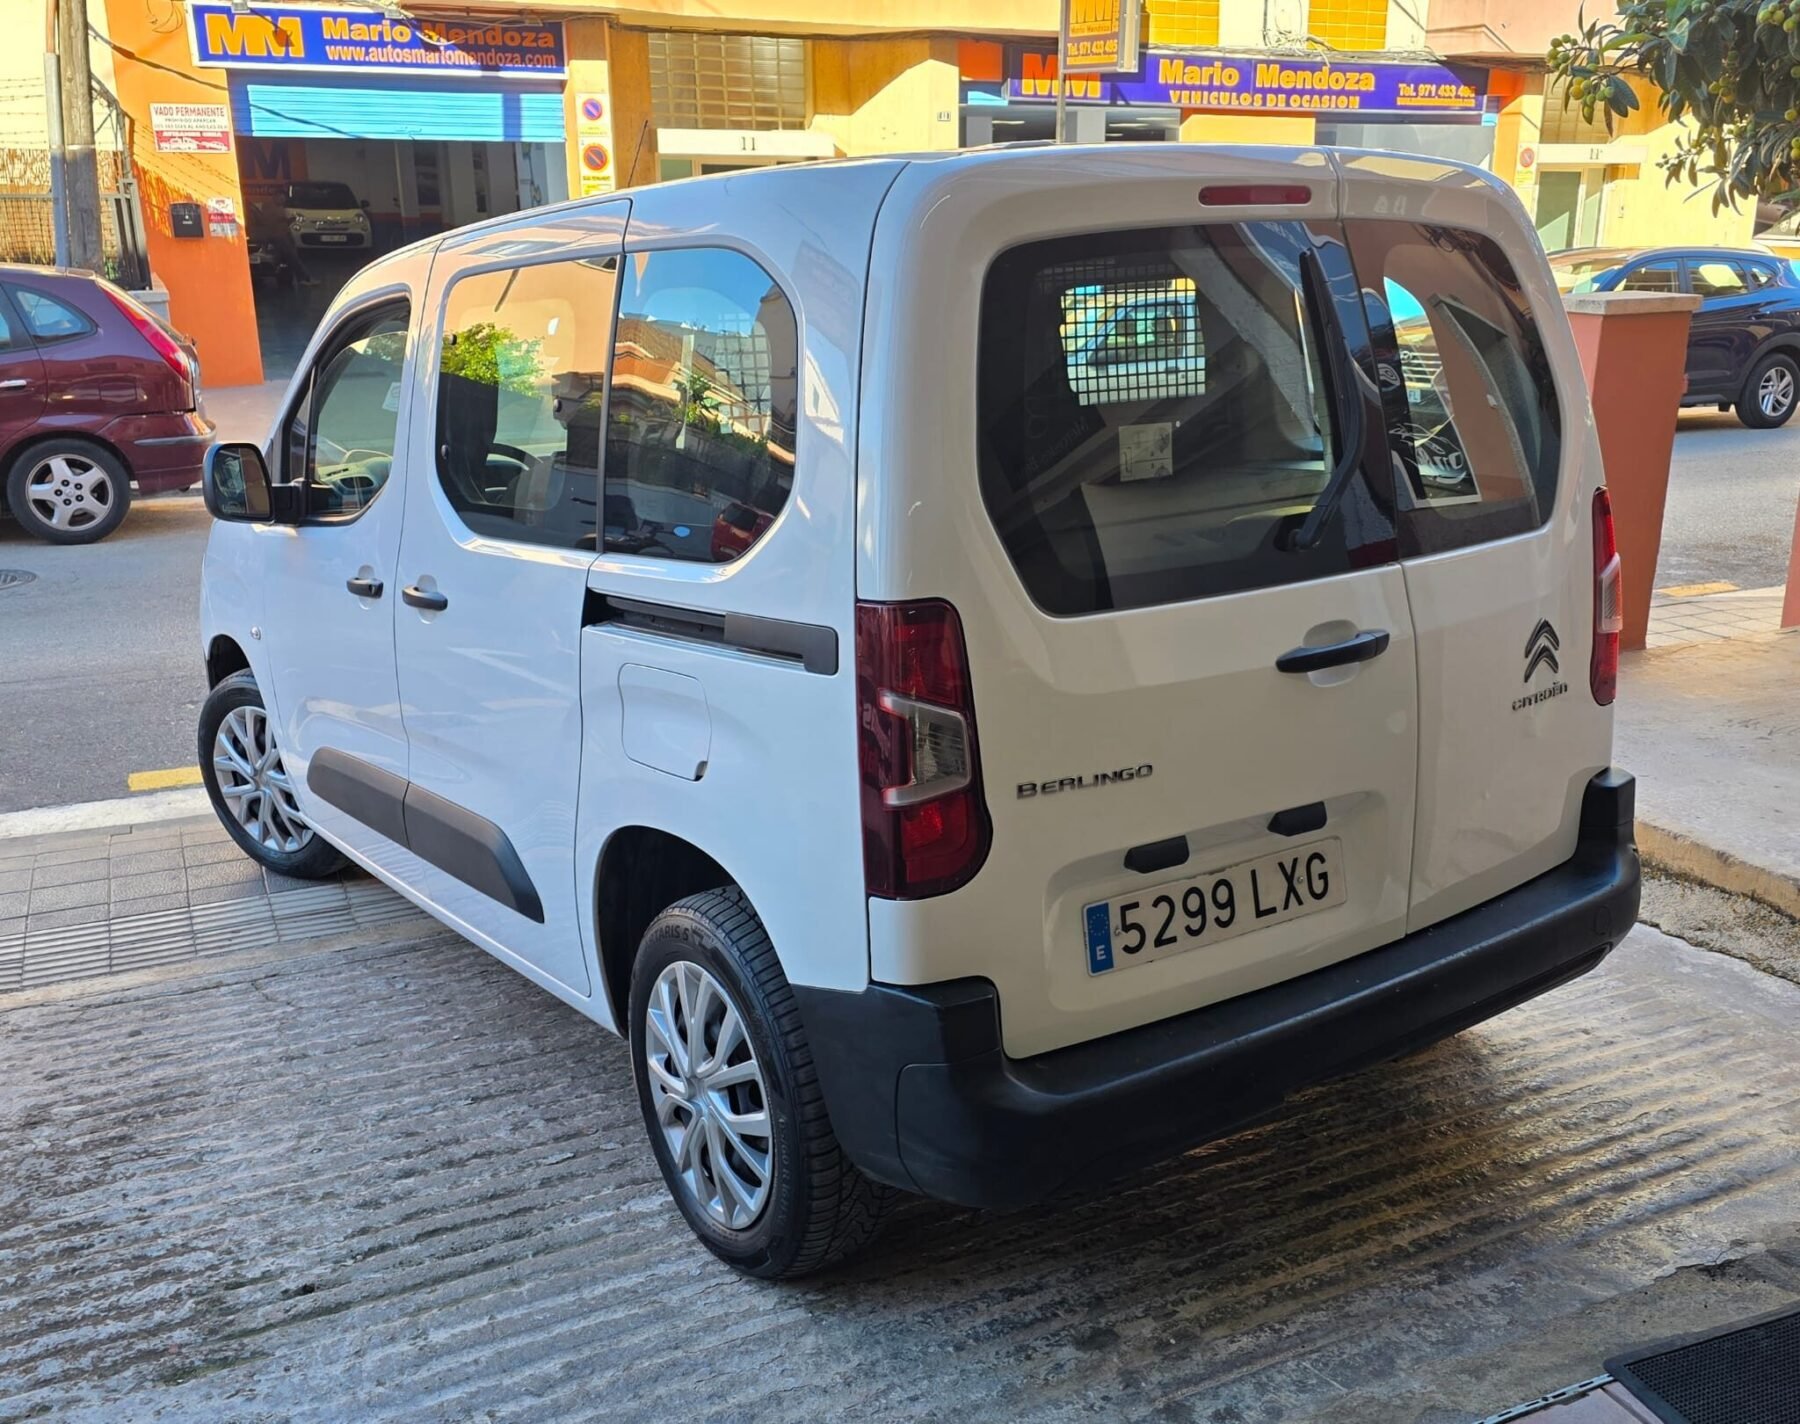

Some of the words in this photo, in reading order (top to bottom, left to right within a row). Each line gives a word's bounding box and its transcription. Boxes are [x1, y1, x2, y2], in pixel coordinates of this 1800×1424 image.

[204, 13, 305, 58] MM
[321, 17, 412, 44] Mario
[420, 20, 555, 49] Mendoza
[325, 43, 557, 69] www.autosmariomendoza.com
[1158, 58, 1240, 86] Mario
[1256, 63, 1376, 91] Mendoza
[1169, 89, 1263, 107] VEHICULOS
[1267, 94, 1287, 107] DE
[1290, 94, 1360, 109] OCASION
[1398, 83, 1416, 96] Tel.
[1418, 83, 1436, 97] 971
[153, 106, 174, 116] VADO
[175, 107, 225, 117] PERMANENTE
[741, 136, 756, 151] 11
[1016, 764, 1154, 800] BERLINGO
[1119, 878, 1236, 955] 5299
[1249, 851, 1329, 919] LXG
[1096, 944, 1107, 960] E
